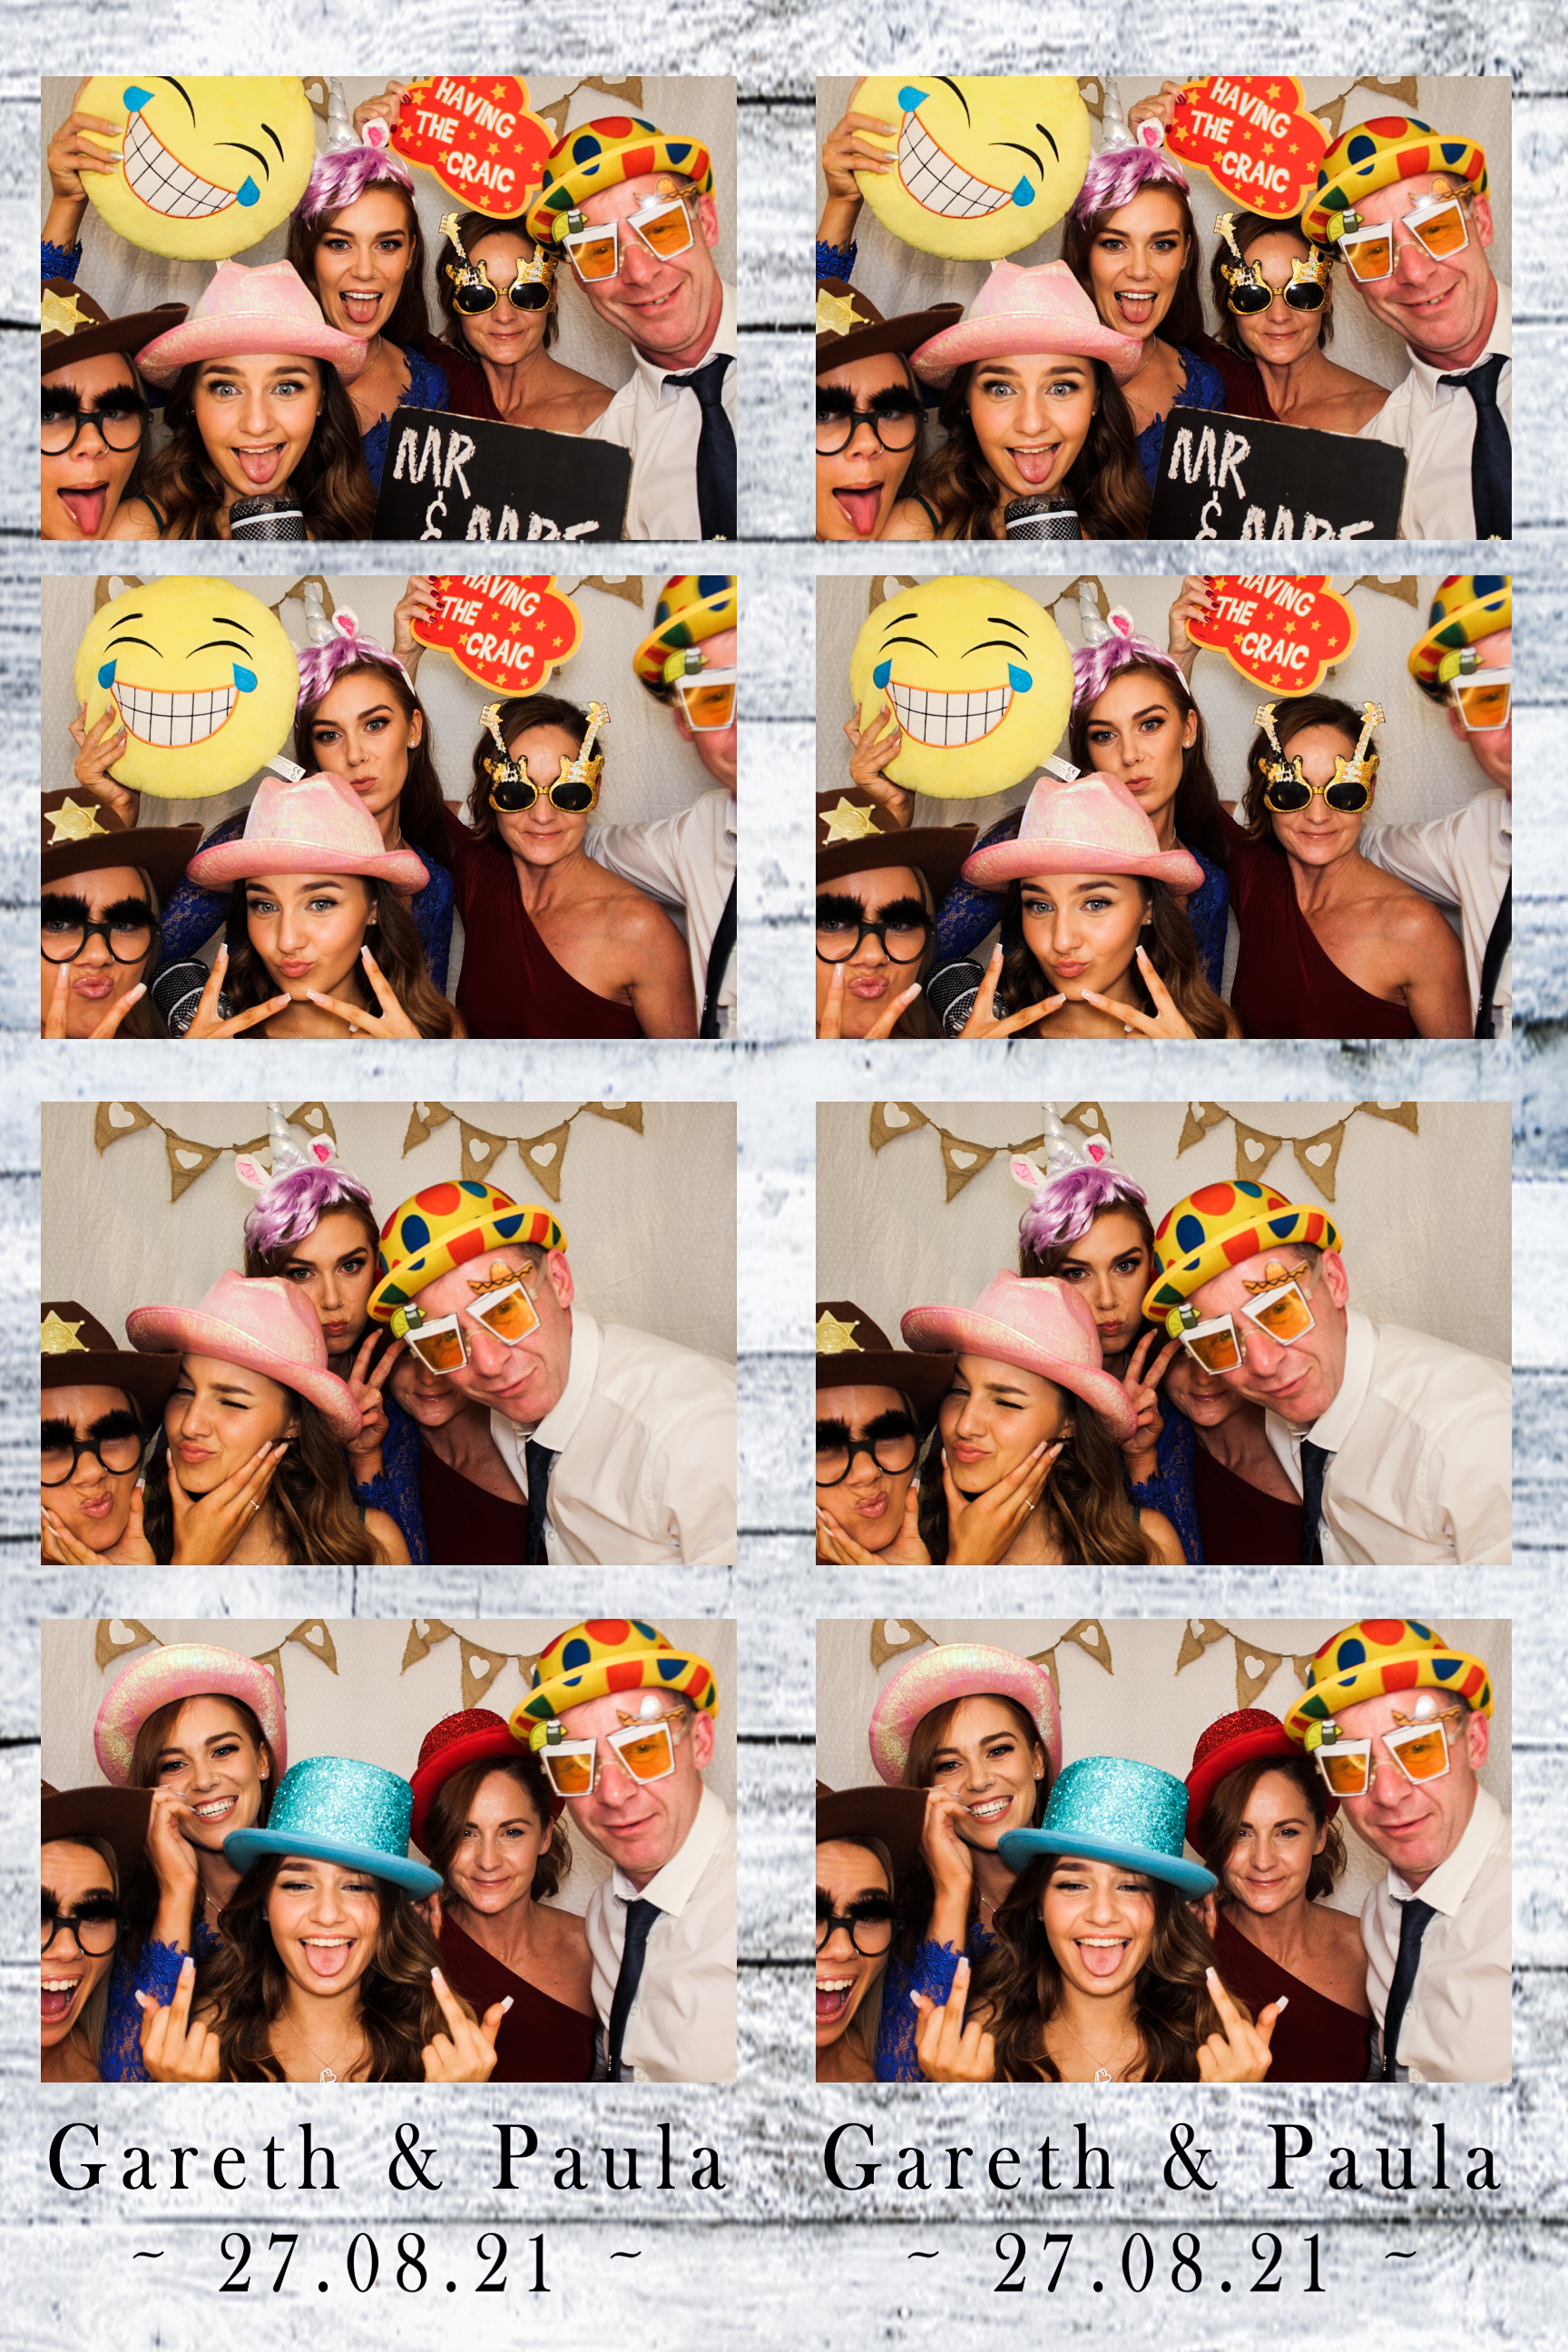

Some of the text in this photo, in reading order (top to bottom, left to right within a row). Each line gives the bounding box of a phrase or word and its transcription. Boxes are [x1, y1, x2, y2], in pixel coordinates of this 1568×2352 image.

[416, 110, 459, 144] THE
[435, 77, 516, 138] HAVING
[1191, 110, 1234, 144] THE
[1210, 77, 1291, 138] HAVING
[446, 151, 514, 192] CRAIC
[1221, 151, 1289, 192] CRAIC
[393, 426, 475, 499] MR
[1168, 426, 1250, 499] MR
[441, 595, 484, 626] THE
[1216, 595, 1259, 626] THE
[466, 632, 534, 670] CRAIC
[1240, 632, 1309, 670] CRAIC
